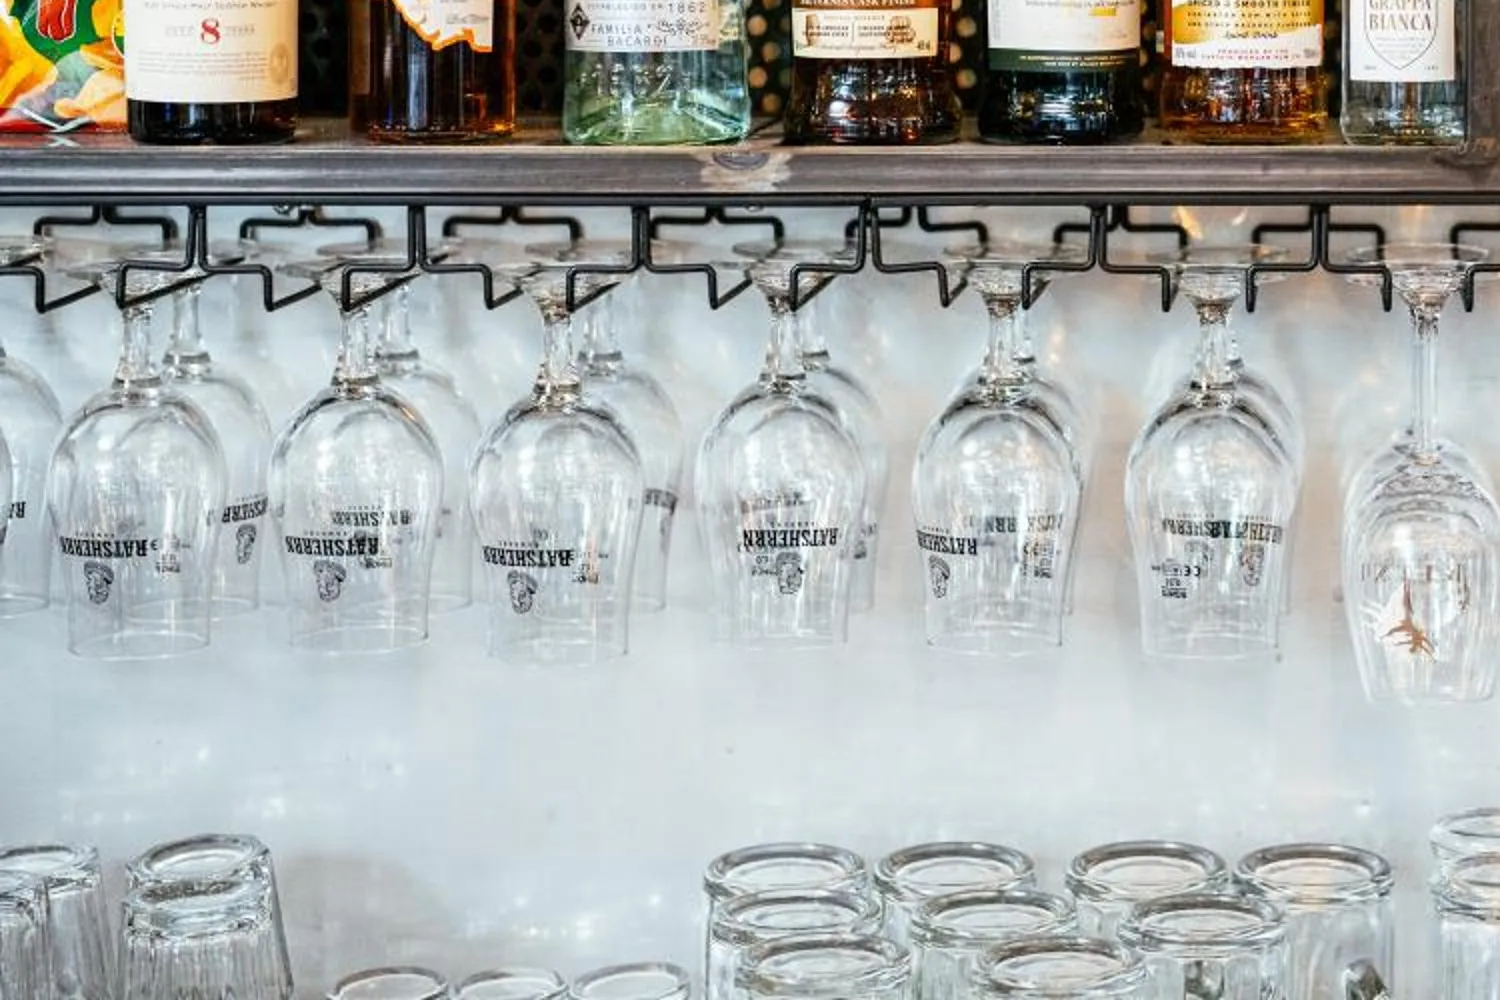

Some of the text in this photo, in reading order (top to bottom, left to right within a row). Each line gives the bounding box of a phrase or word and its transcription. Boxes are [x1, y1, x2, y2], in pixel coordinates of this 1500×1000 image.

[667, 1, 706, 14] 1862
[200, 18, 221, 45] 8
[1369, 13, 1431, 31] BIANCA
[743, 528, 840, 548] RATSHERRN
